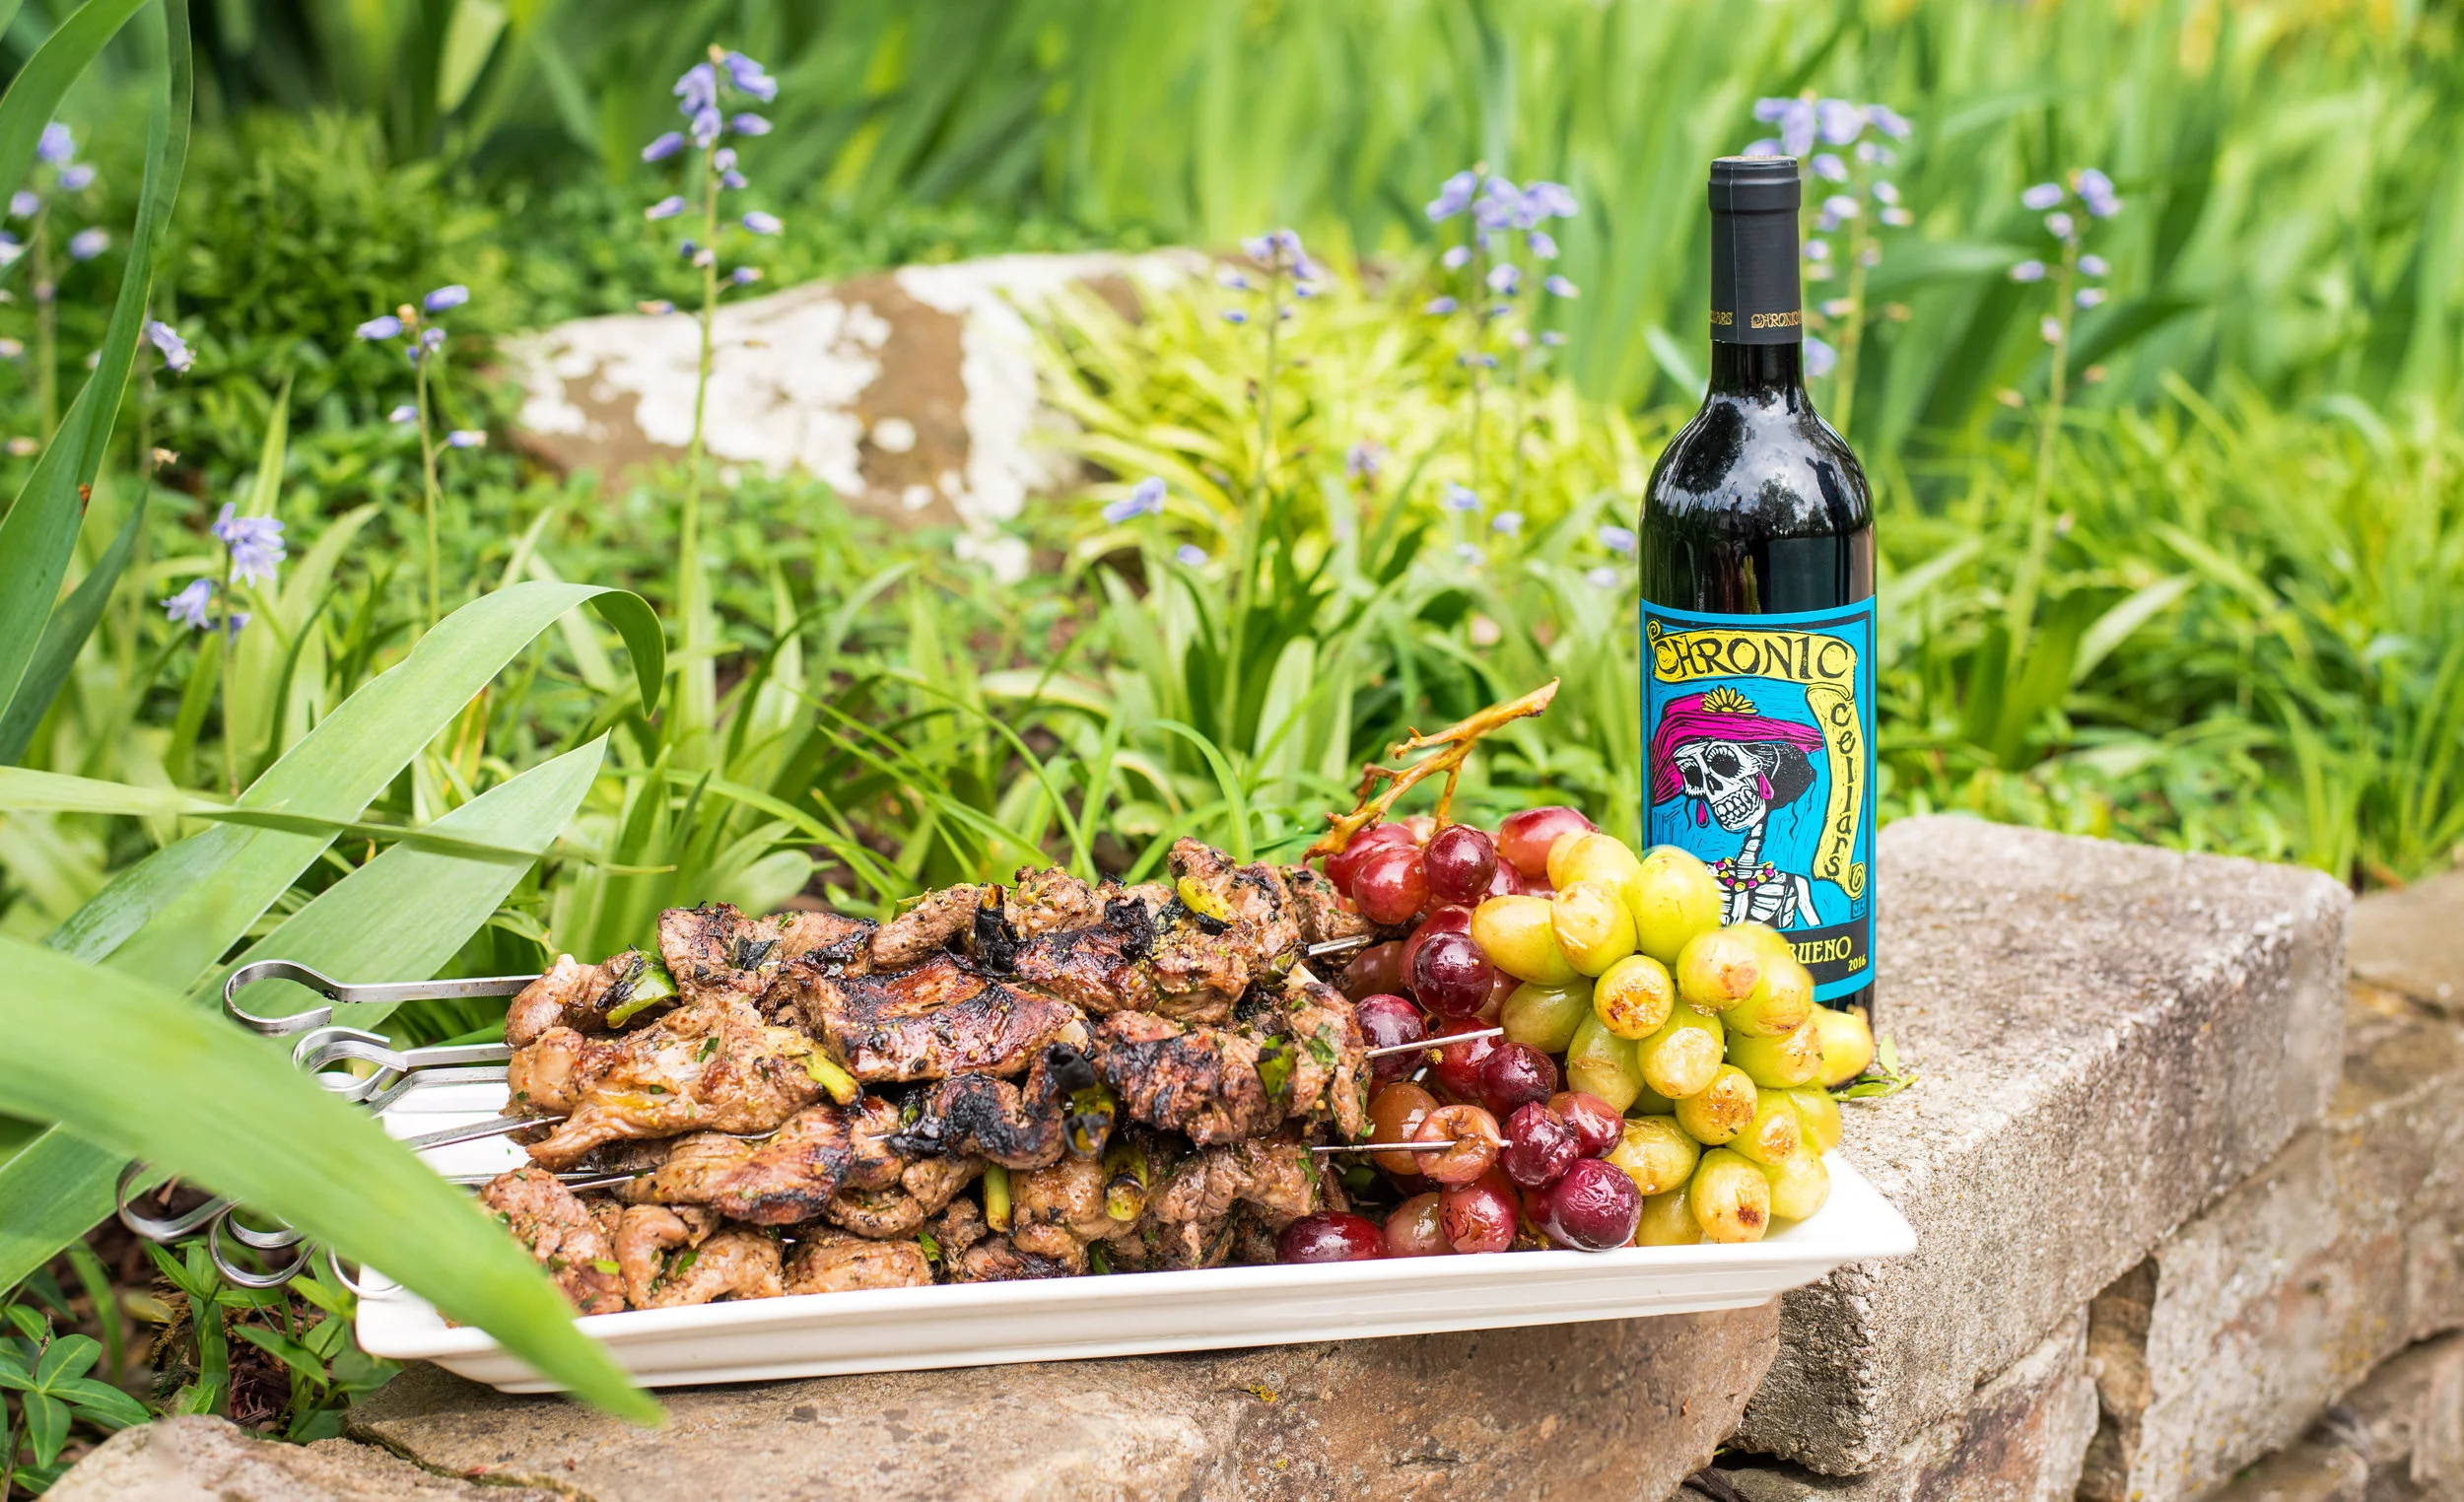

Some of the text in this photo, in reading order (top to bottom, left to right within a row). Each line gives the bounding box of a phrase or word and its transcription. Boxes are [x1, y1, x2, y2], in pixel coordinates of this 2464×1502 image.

[1654, 635, 1849, 680] CHRONIC
[1786, 935, 1852, 964] BUENO
[1848, 954, 1867, 972] 2016
